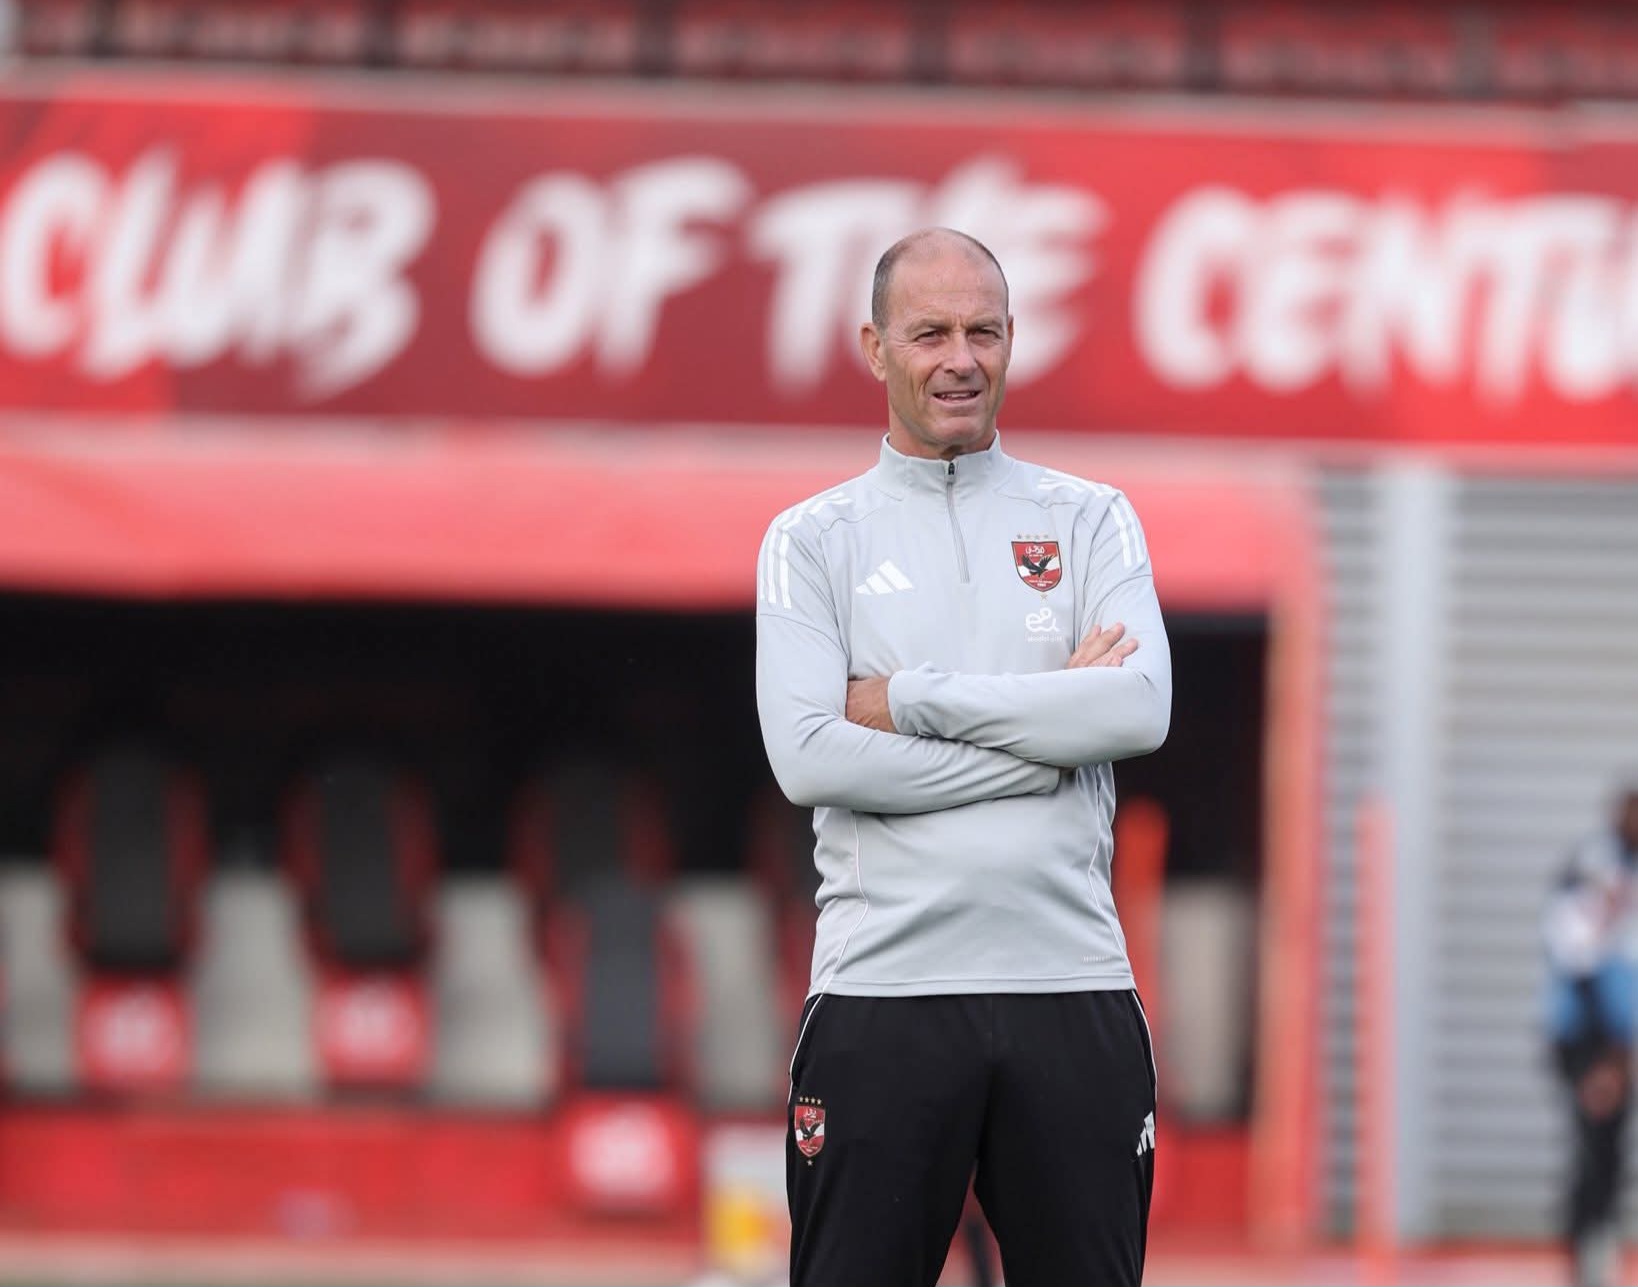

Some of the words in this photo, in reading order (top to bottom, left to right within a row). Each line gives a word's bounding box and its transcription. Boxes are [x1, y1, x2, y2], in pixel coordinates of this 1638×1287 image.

[0, 147, 437, 400] CLUB
[470, 157, 753, 384] OF
[746, 155, 1112, 398] TE
